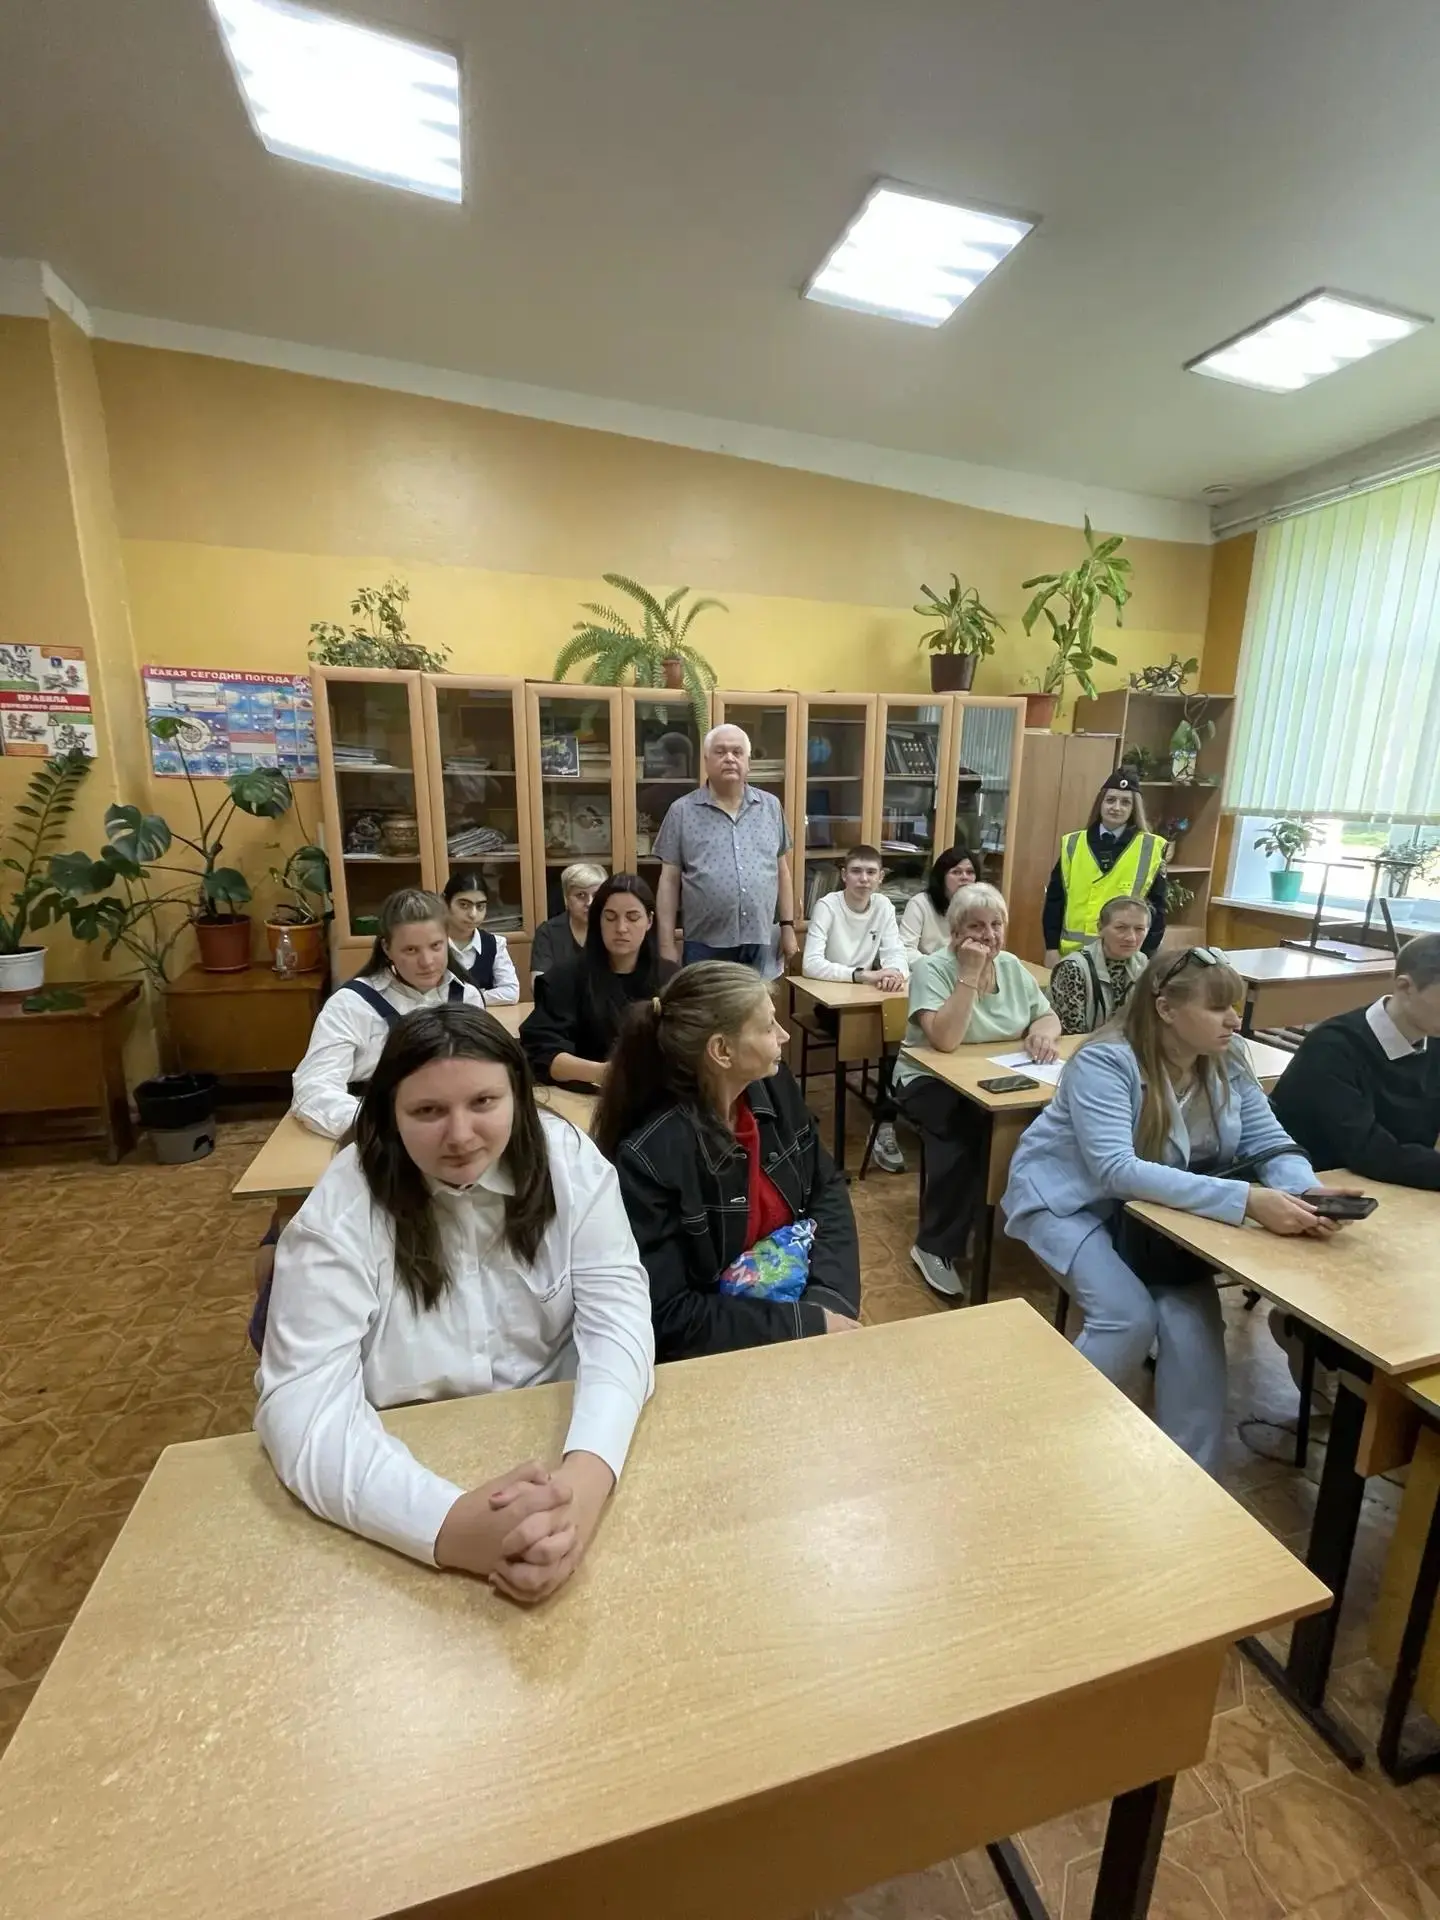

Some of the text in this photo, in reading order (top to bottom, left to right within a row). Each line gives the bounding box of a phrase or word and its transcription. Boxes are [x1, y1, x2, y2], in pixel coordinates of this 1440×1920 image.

[150, 668, 290, 684] КАКАЯ СЕГОДНЯ ПОГОДА
